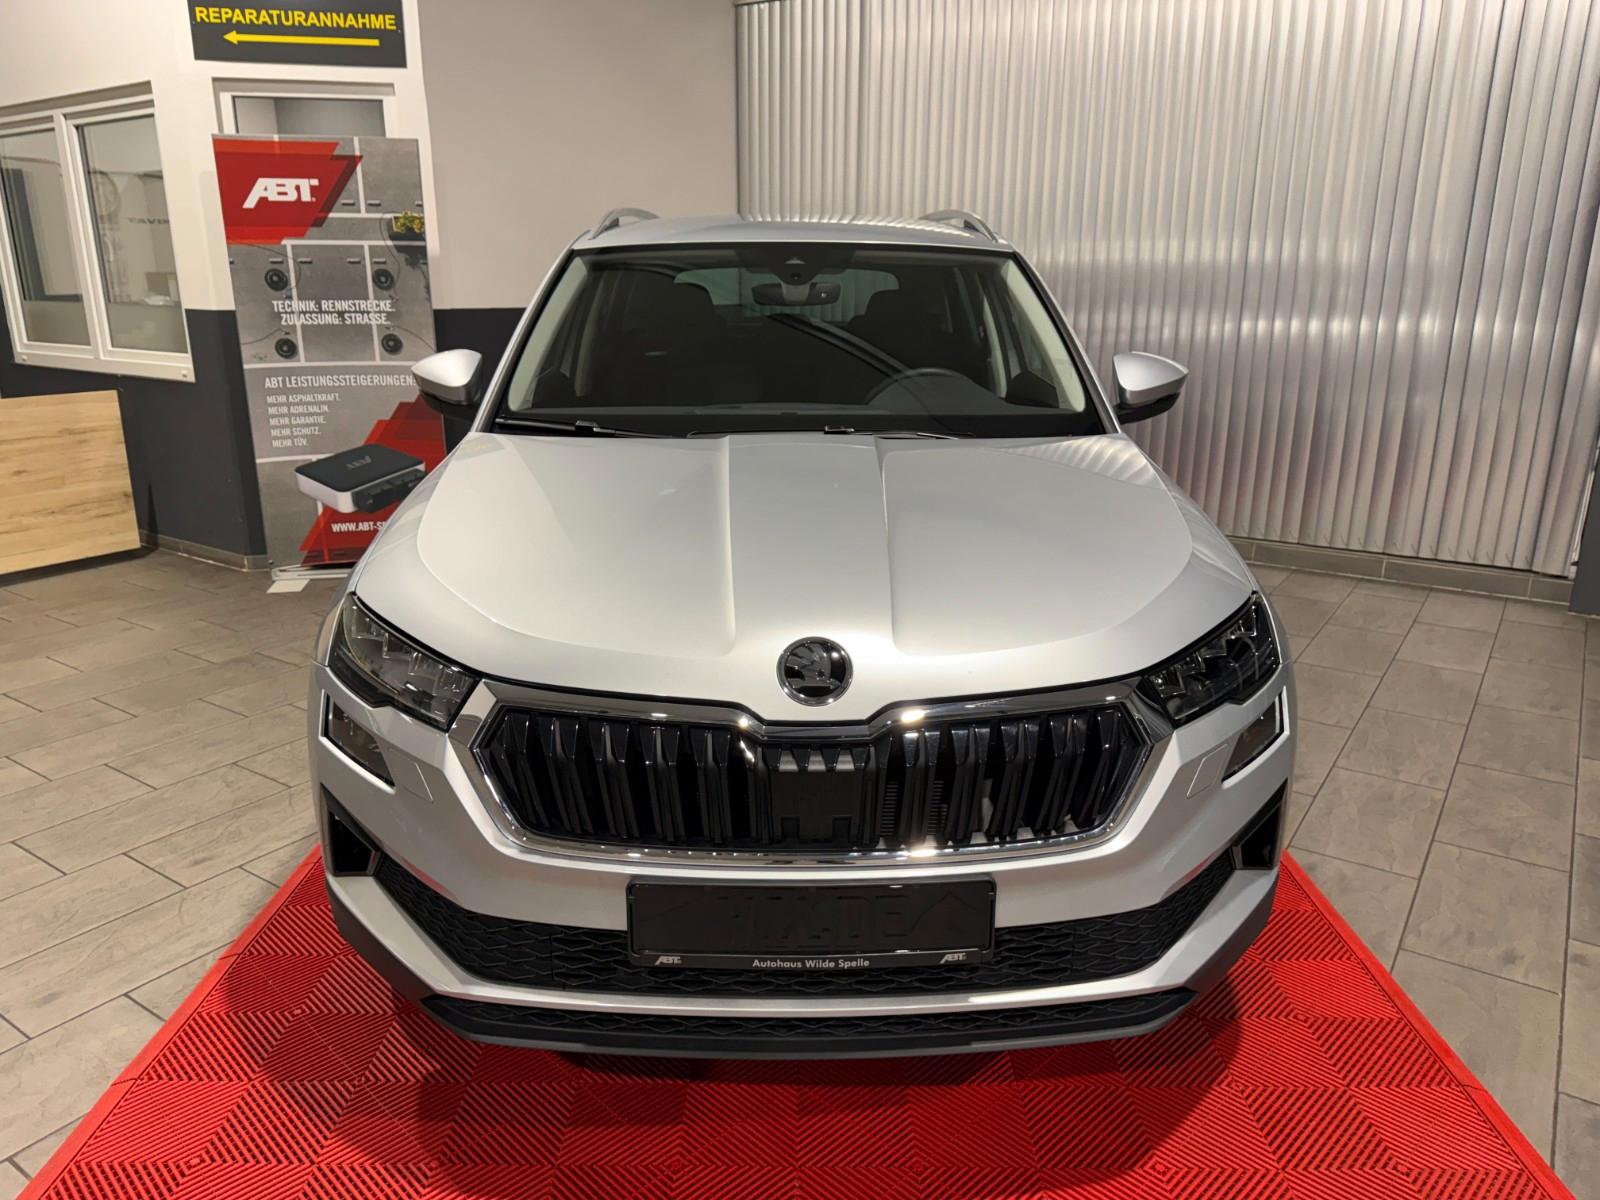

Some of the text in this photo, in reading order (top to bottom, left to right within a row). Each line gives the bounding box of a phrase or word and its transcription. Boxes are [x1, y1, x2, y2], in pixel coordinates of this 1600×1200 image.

[195, 6, 396, 30] REPARATURANNAHME
[242, 178, 319, 209] ABT
[272, 300, 395, 312] TECHNIK: RENNSTRECKE.
[281, 313, 391, 325] ZULASSUNG: STRASSE.
[265, 376, 283, 388] ABT
[266, 395, 288, 403] MEHR
[268, 406, 289, 414] MEHR
[269, 417, 290, 425] MEHR
[271, 428, 291, 436] MEHR
[272, 439, 293, 447] MEHR
[752, 958, 870, 969] Autohaus Wilde Spelle
